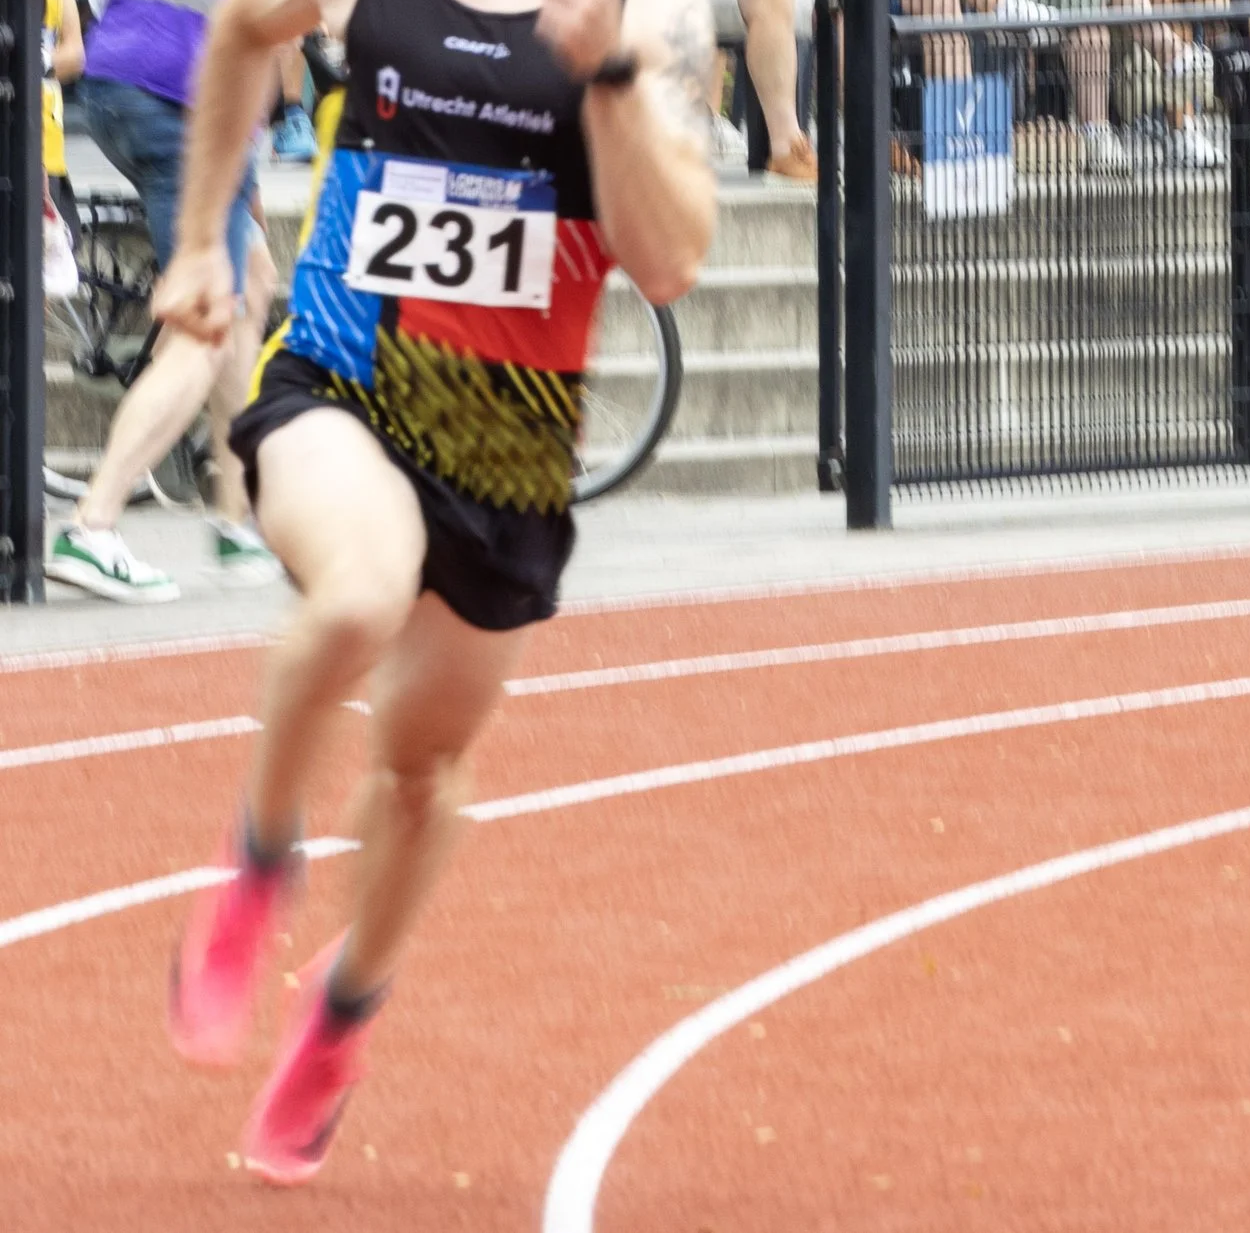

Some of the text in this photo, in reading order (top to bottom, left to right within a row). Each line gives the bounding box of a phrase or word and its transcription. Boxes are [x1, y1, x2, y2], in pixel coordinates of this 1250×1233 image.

[443, 35, 497, 58] CRAFT
[402, 87, 555, 134] Utrecht Atletiek
[365, 202, 527, 294] 231
